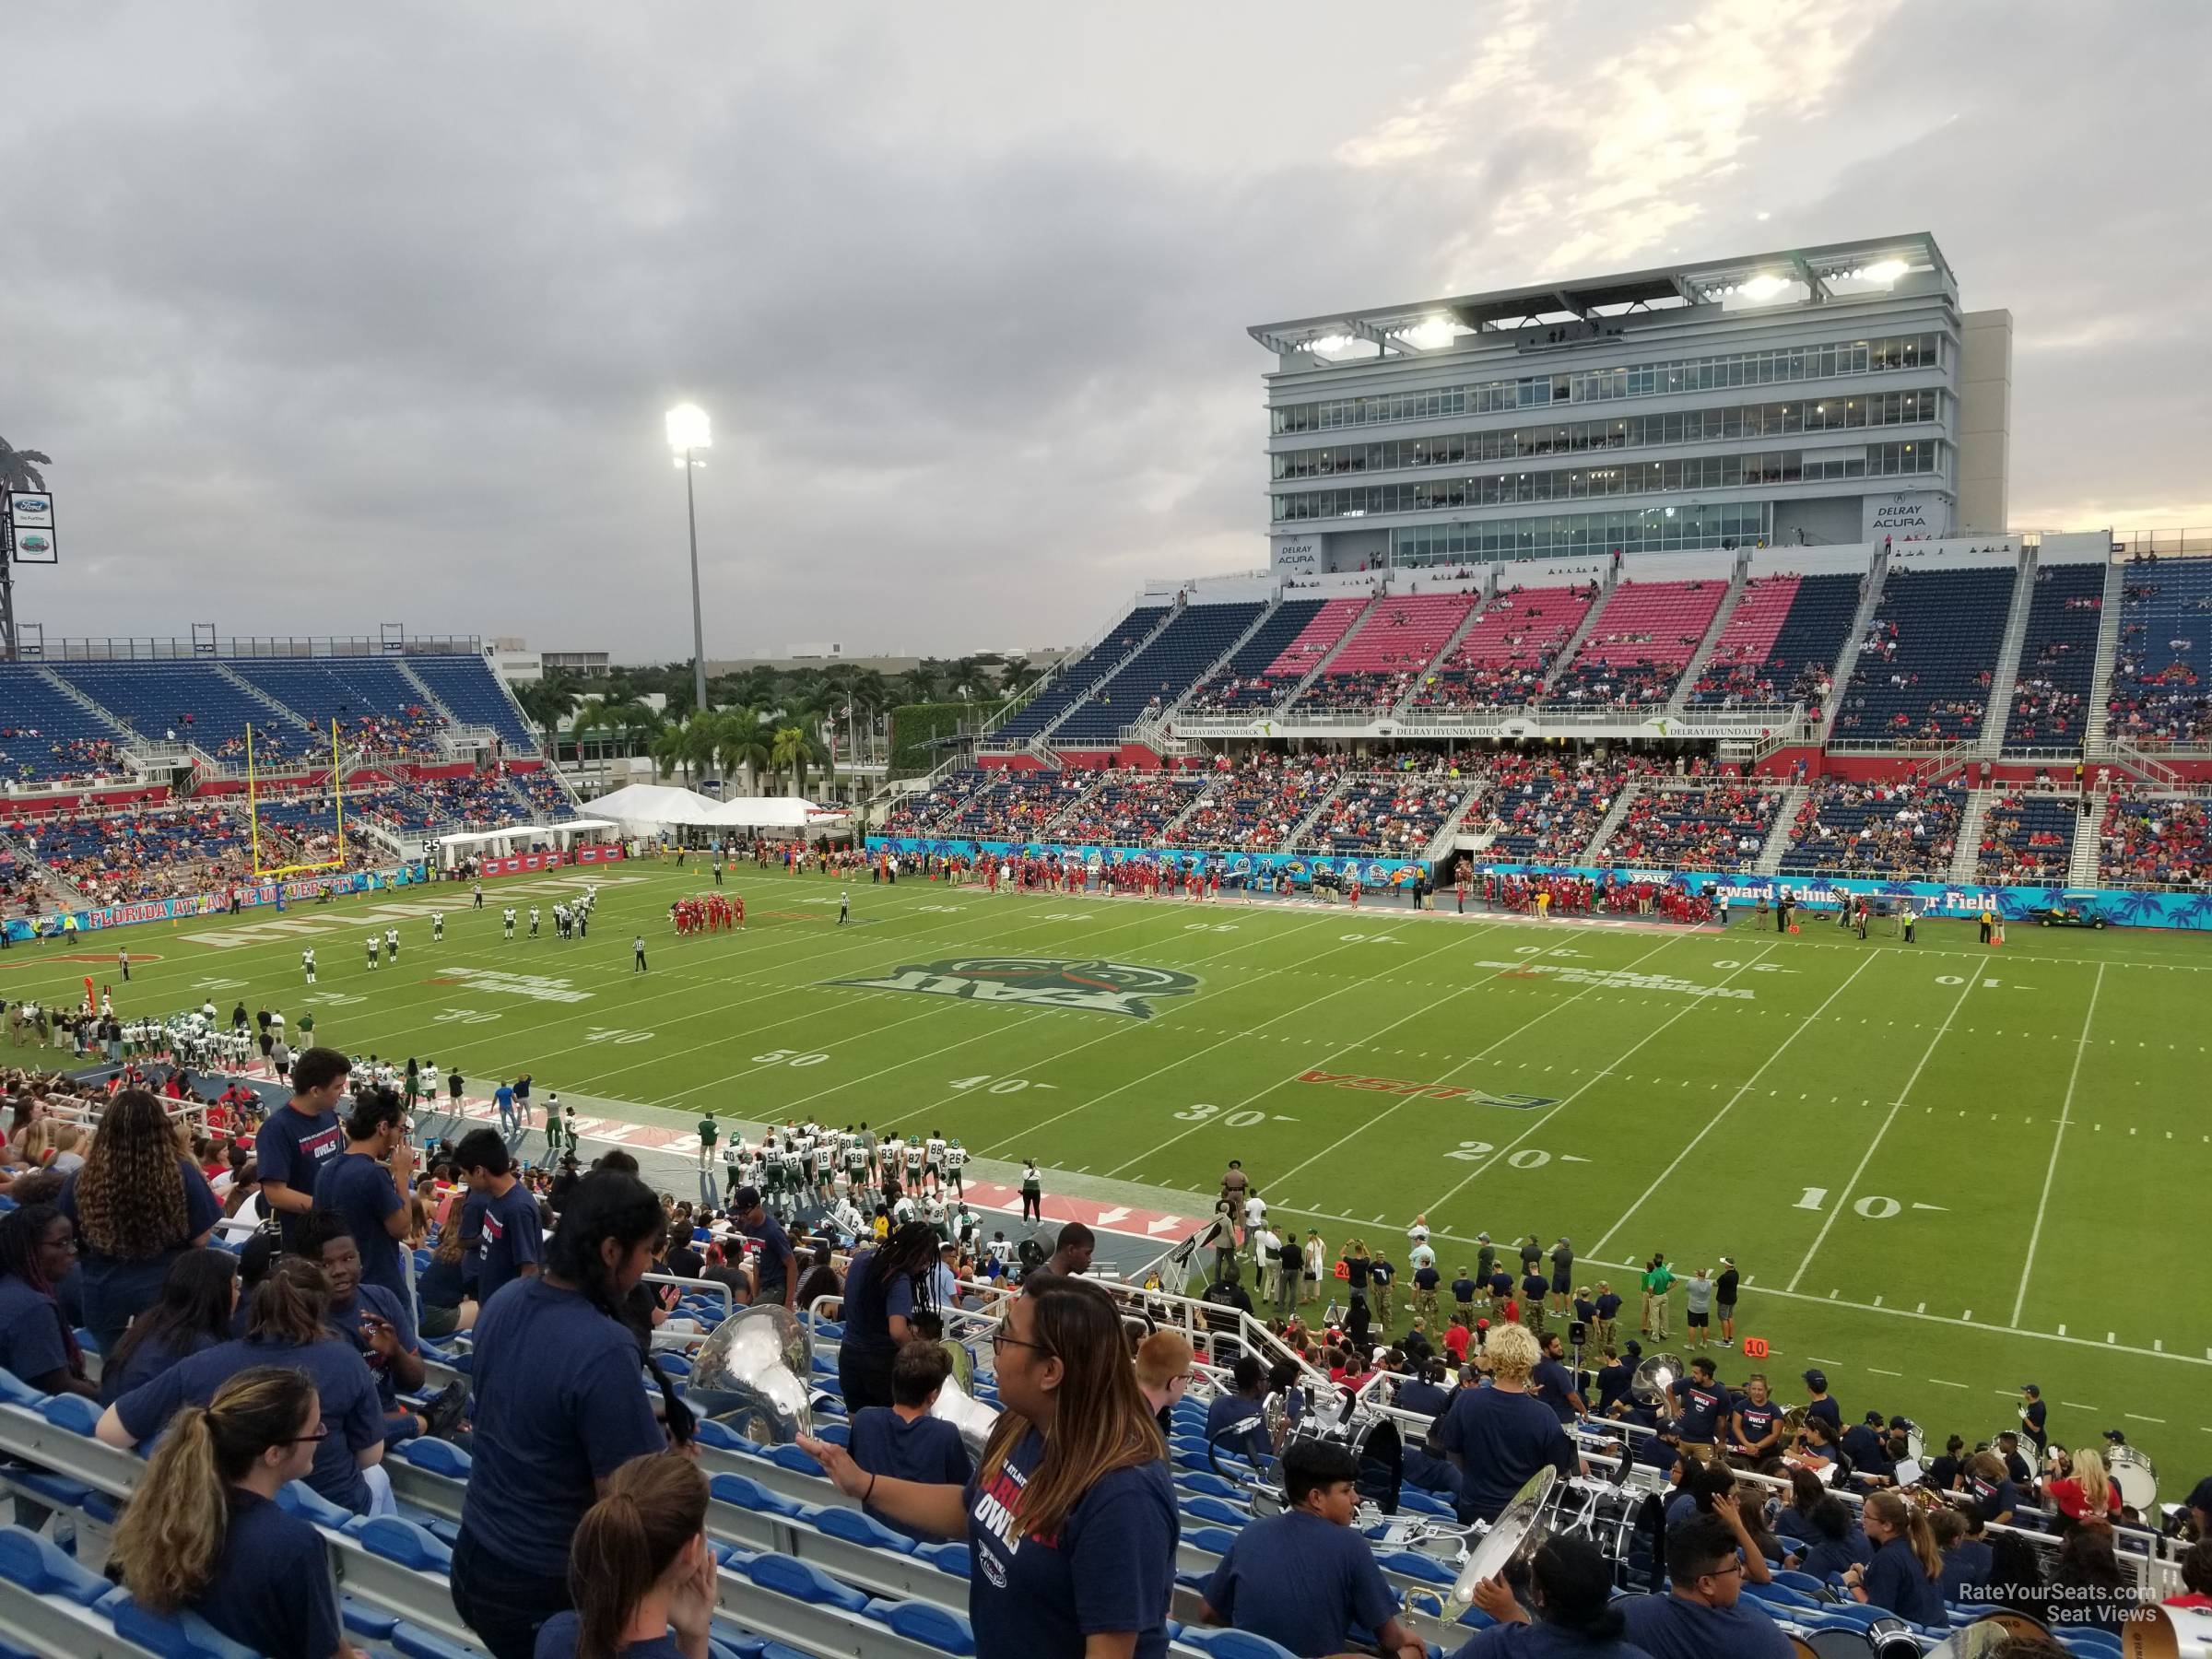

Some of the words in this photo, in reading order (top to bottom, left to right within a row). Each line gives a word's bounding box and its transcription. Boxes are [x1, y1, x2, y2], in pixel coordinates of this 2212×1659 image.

[20, 500, 43, 511] Ford
[1878, 505, 1923, 516] DELRAY
[1873, 518, 1925, 528] ACURA
[1282, 546, 1312, 554] DELRAY
[1278, 555, 1315, 564] ACURA
[1396, 728, 1431, 736] DELRAY
[1433, 728, 1477, 736] HYUNDAI
[1478, 728, 1504, 736] DECK
[1670, 728, 1705, 736] DELRAY
[1708, 728, 1752, 736] HYUNDAI
[425, 839, 441, 853] 25
[1947, 892, 1997, 911] Field
[89, 899, 167, 927] FLORIDA
[1935, 975, 2001, 989] 10
[433, 1007, 503, 1024] 30
[584, 1028, 656, 1044] 40
[751, 1049, 830, 1066] 50
[947, 1075, 1030, 1094] 40
[1172, 1103, 1266, 1127] 30
[314, 1139, 336, 1159] OWLS
[1443, 1141, 1552, 1169] 20
[1792, 1186, 1901, 1218] 10
[1747, 1339, 1765, 1355] 10
